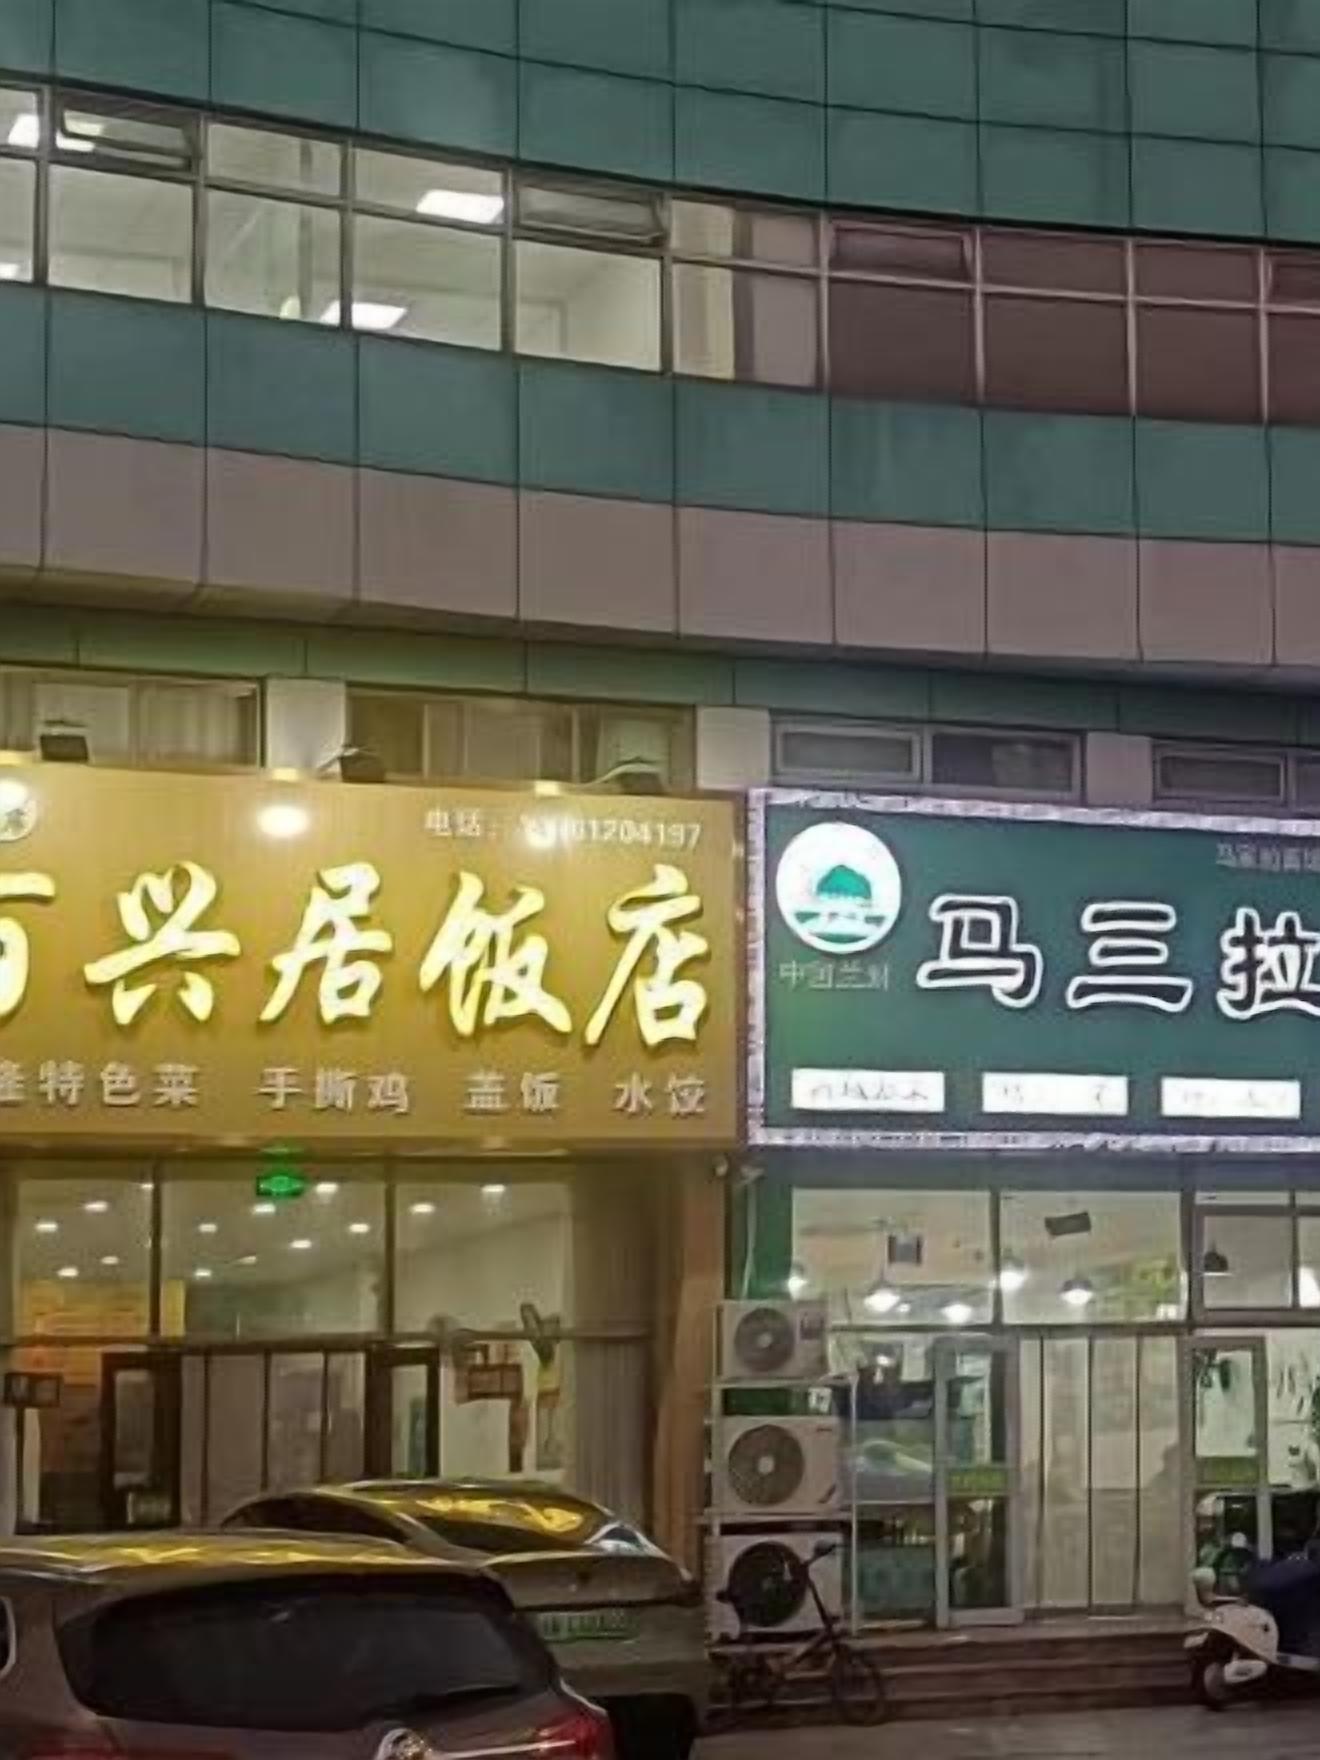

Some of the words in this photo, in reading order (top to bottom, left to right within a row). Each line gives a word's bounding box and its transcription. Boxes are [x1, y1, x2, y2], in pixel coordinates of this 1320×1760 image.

[257, 1066, 409, 1114] 手撕鸡
[465, 1071, 560, 1112] 盖饭
[612, 1072, 705, 1113] 水饺
